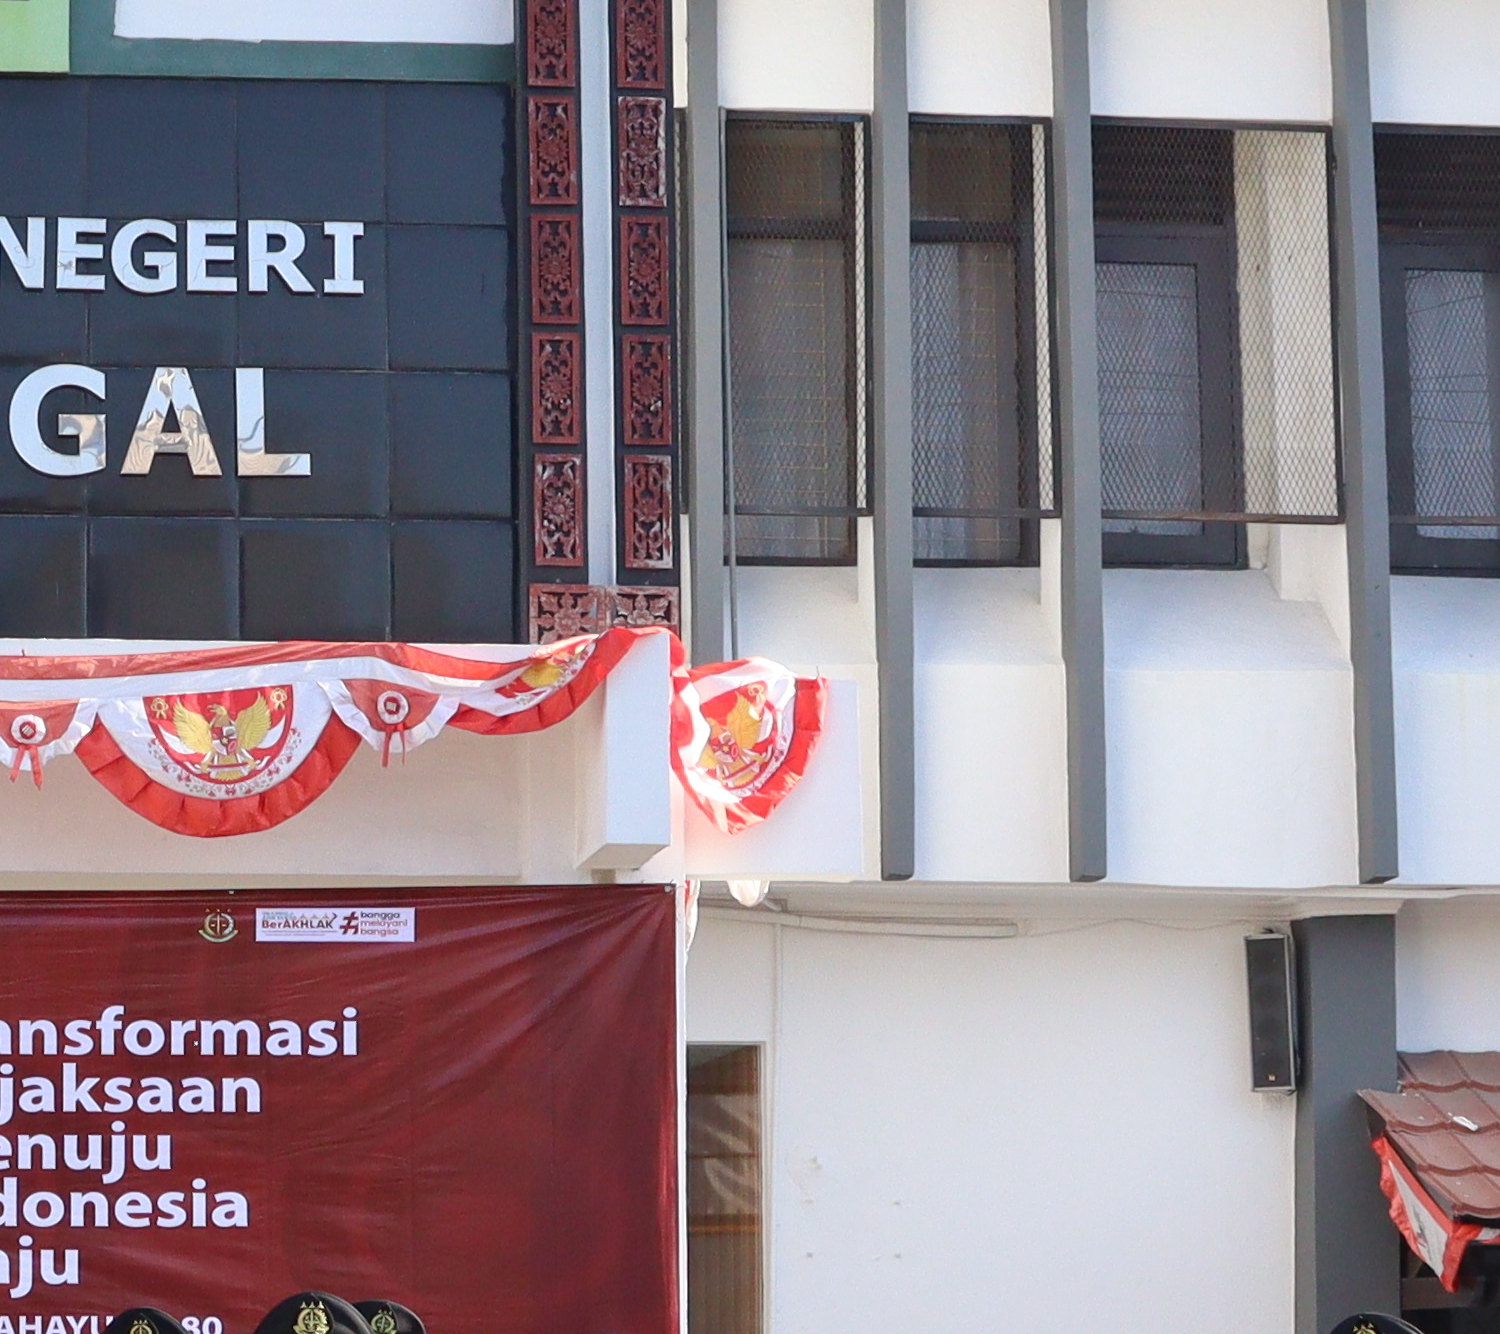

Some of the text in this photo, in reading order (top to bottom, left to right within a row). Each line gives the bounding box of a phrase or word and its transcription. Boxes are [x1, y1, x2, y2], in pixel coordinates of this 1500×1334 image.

[262, 915, 337, 929] BerAKHLAK
[361, 911, 400, 920] bangga
[361, 929, 399, 937] bangsa
